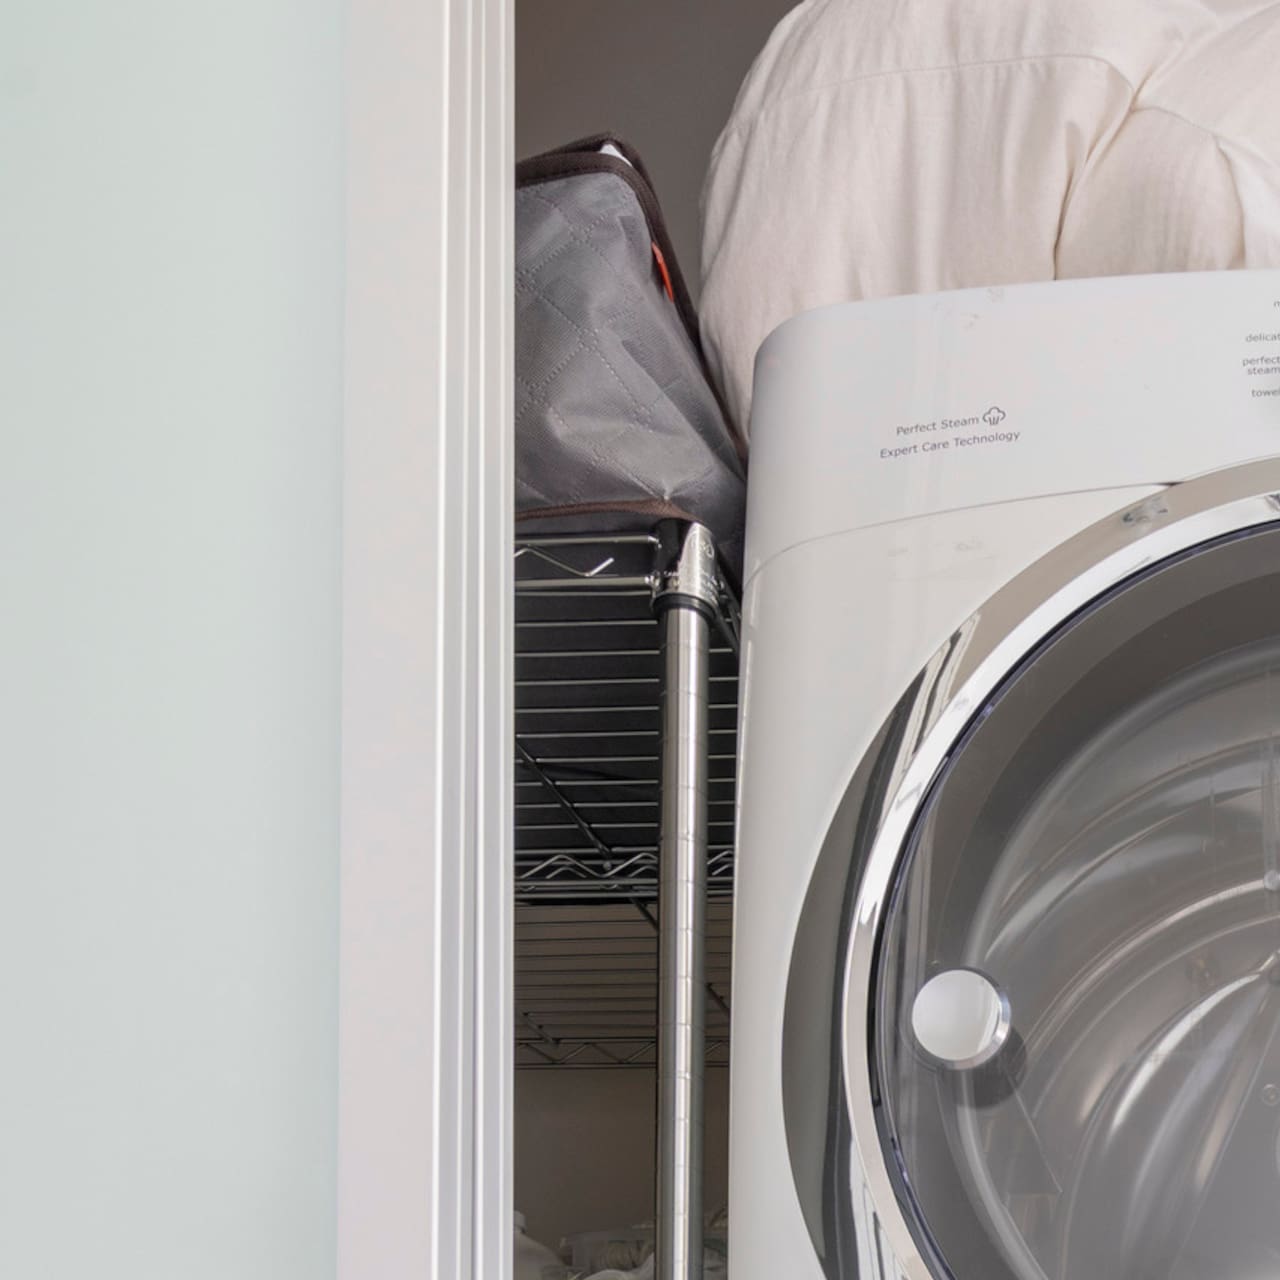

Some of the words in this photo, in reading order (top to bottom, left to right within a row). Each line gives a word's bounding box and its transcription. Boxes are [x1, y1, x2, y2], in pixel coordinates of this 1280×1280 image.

[1242, 356, 1280, 367] perfect
[1248, 366, 1280, 375] steam
[896, 421, 937, 436] Perfect
[940, 417, 980, 430] Steam
[880, 443, 918, 459] Expert
[922, 439, 950, 452] Care
[954, 430, 1020, 448] Technology
